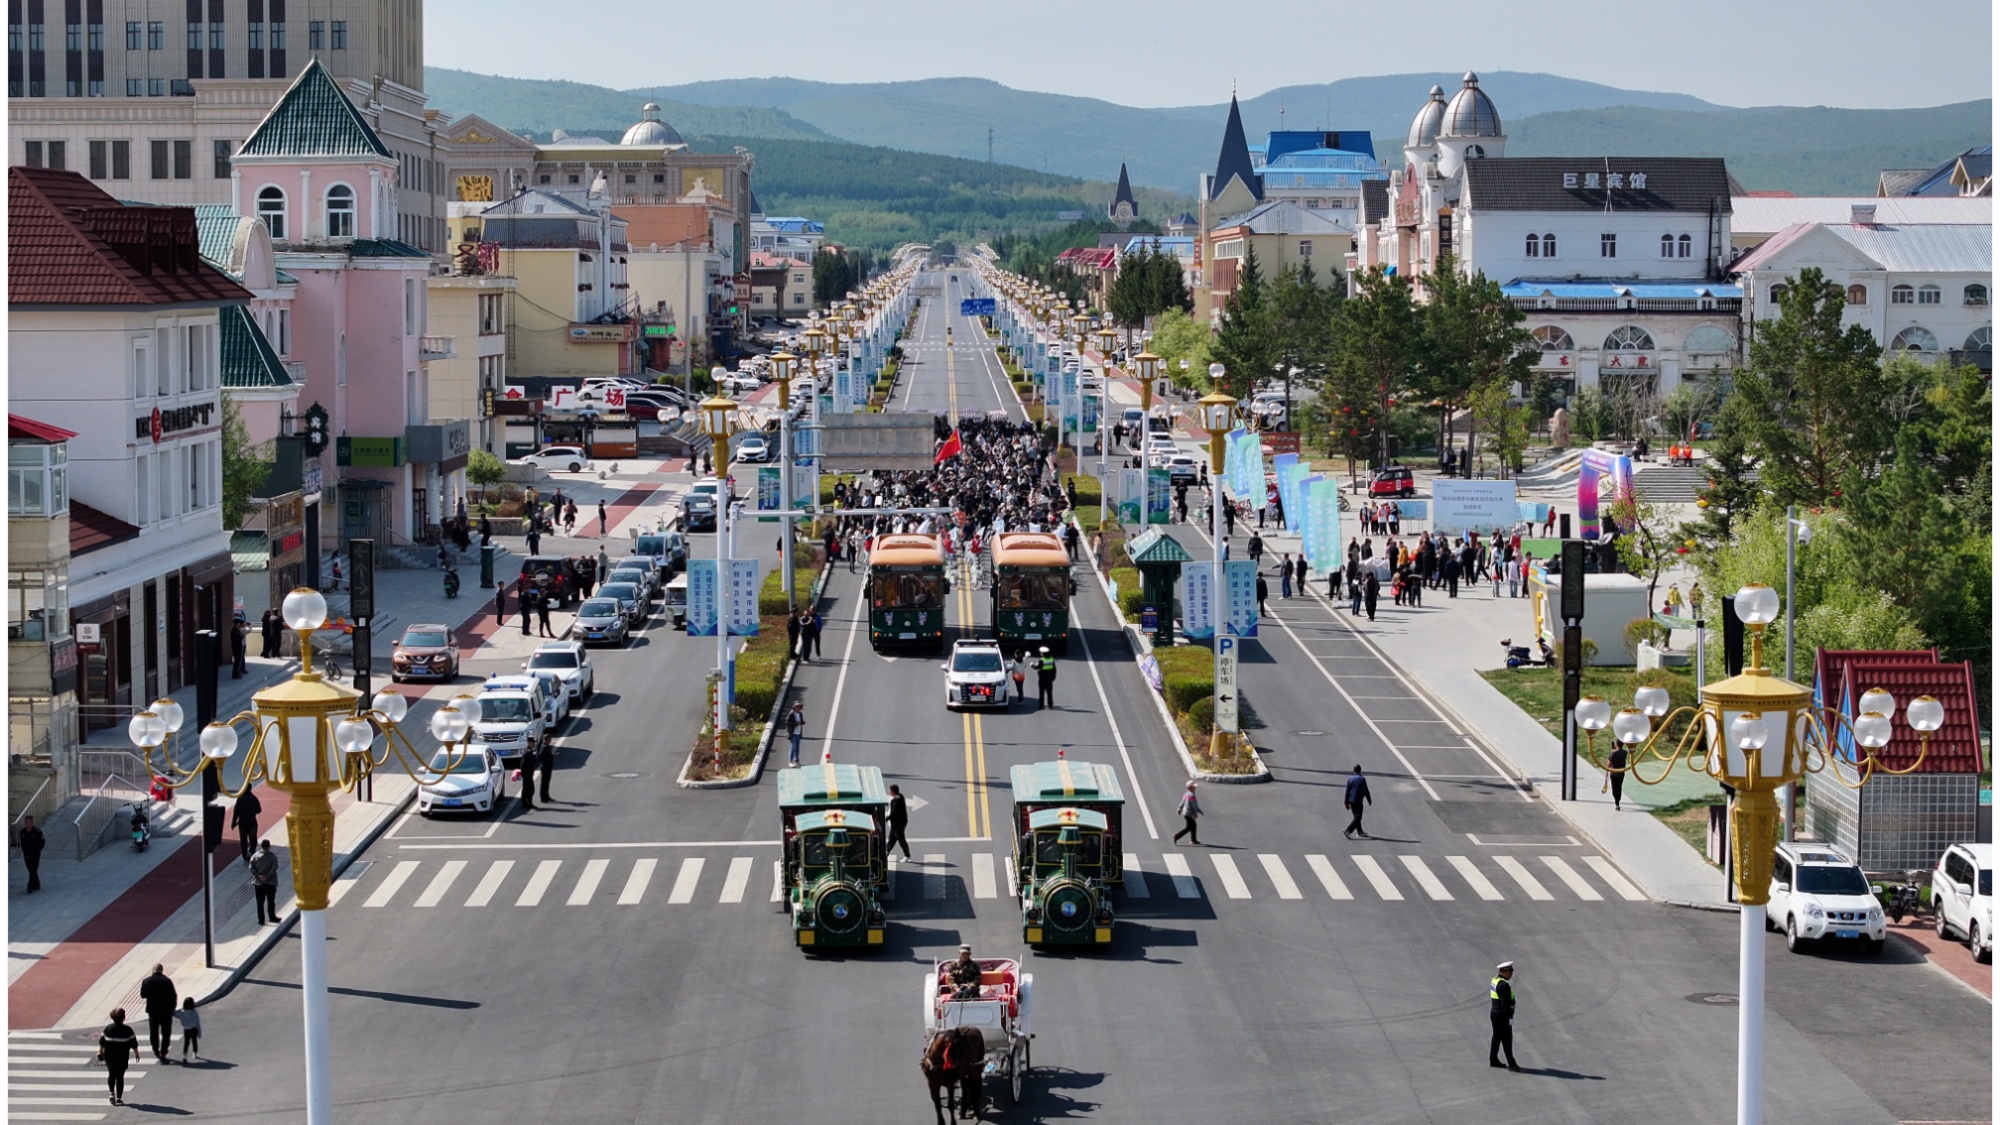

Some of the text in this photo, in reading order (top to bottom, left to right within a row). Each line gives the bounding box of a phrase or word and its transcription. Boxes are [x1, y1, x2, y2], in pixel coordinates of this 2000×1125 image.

[1563, 172, 1647, 189] 巨星宾馆
[1610, 355, 1649, 367] 大院
[1244, 571, 1252, 626] 共建美好家园
[1219, 638, 1233, 655] P
[1220, 657, 1229, 685] 停车场
